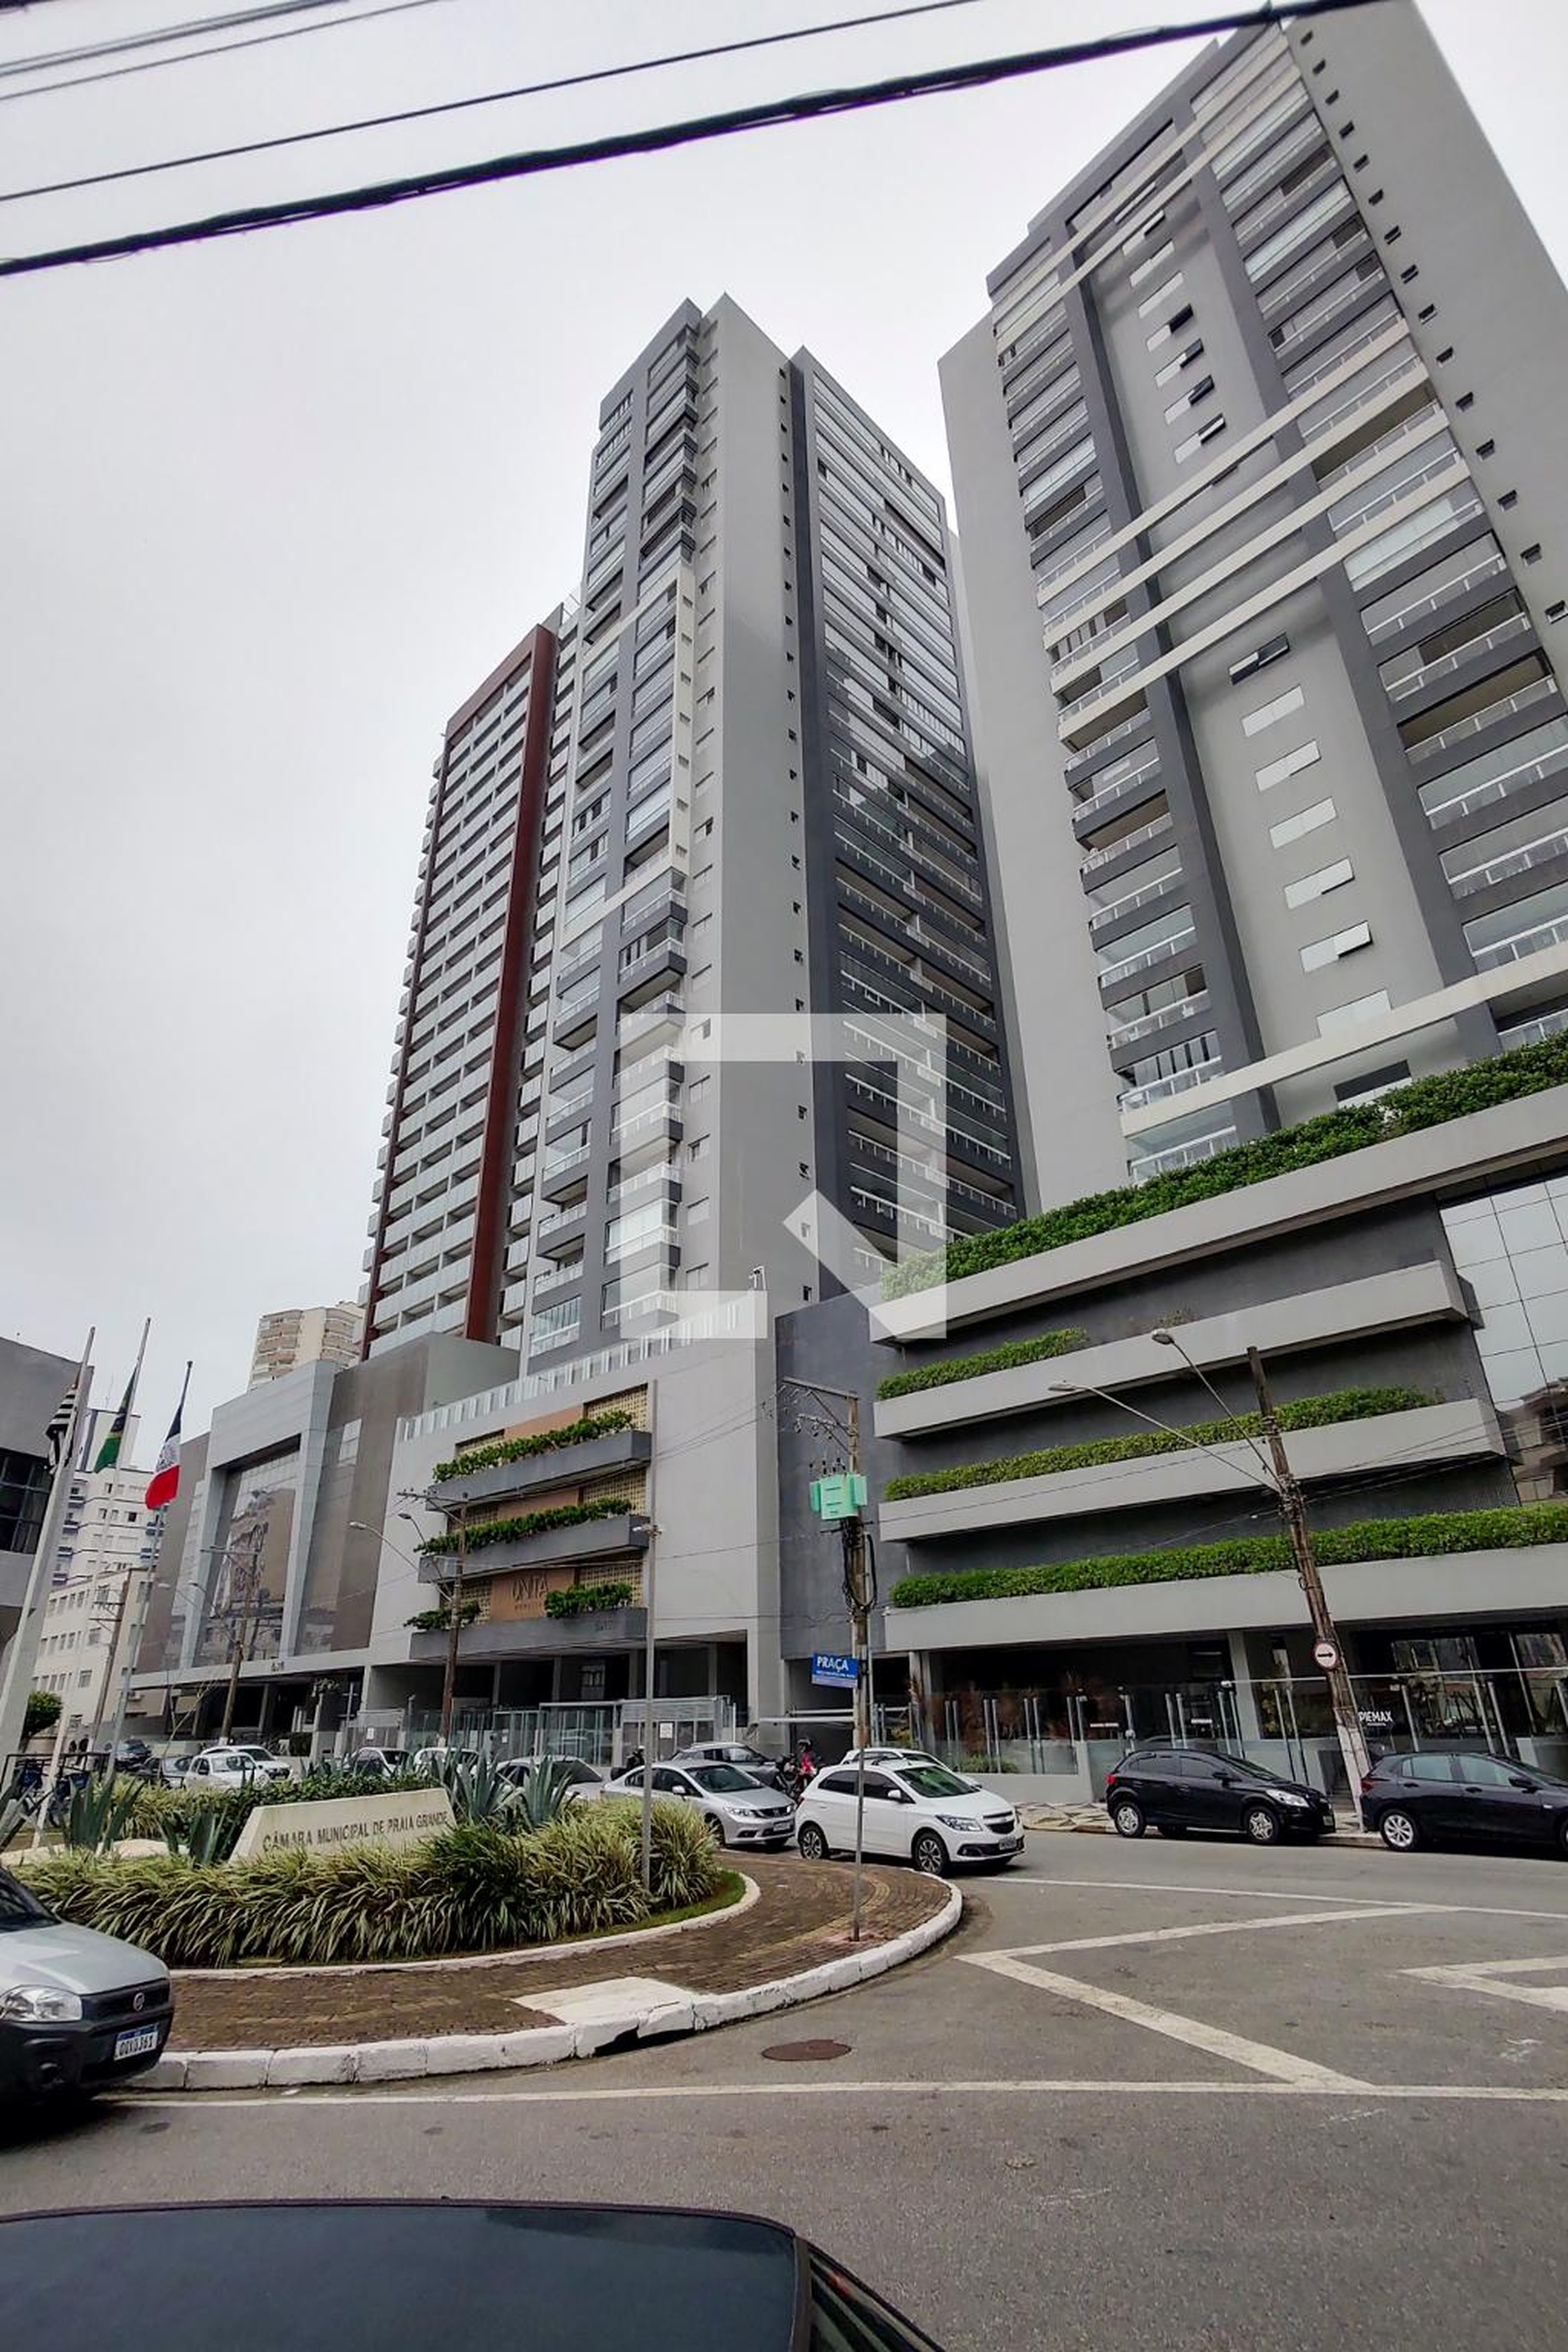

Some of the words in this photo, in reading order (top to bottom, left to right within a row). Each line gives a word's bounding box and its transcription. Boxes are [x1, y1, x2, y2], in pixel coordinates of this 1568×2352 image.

[817, 1656, 849, 1673] PRAÇA
[317, 1822, 369, 1844] MUNICIPAL
[373, 1820, 384, 1835] DE
[388, 1816, 414, 1832] PRAIA
[416, 1811, 448, 1828] GRANDE
